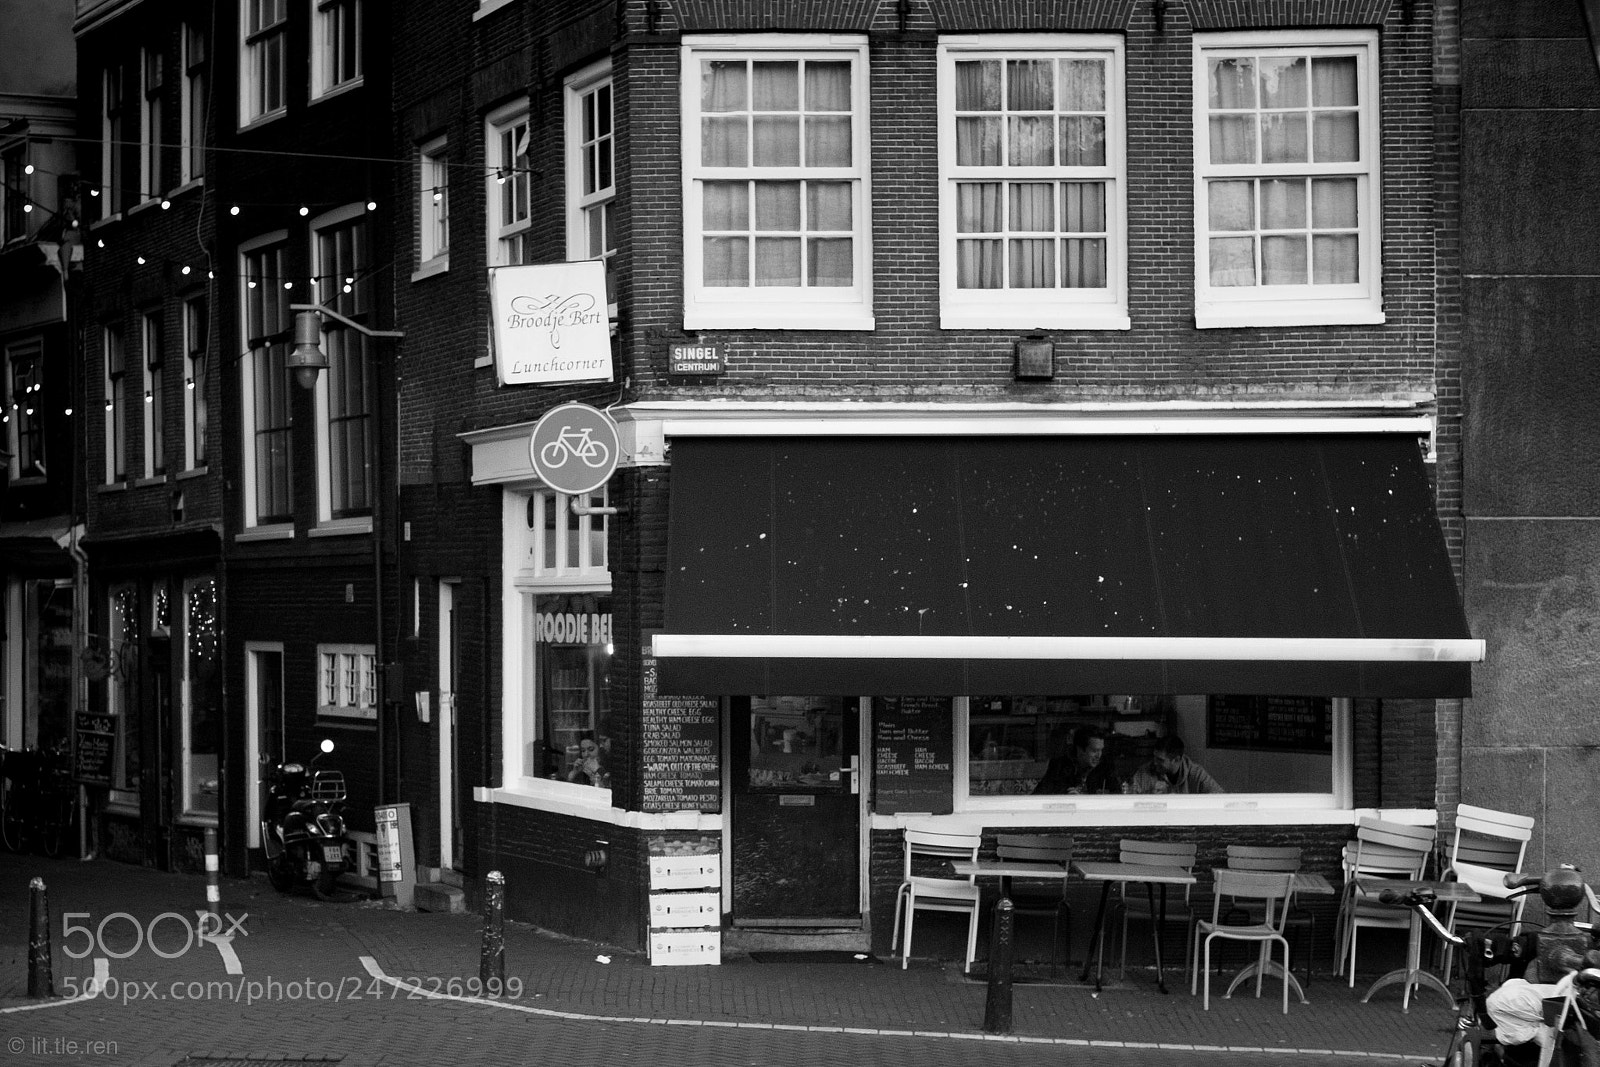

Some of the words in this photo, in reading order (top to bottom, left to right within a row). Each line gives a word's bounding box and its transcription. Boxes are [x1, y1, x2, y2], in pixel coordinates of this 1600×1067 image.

[507, 309, 565, 330] Broodje
[569, 309, 602, 327] Bert
[674, 346, 719, 361] SINGEL
[511, 356, 605, 375] Lunchcorner
[674, 362, 720, 372] (CENTRUM)
[536, 612, 588, 644] ROODJE
[643, 708, 666, 716] HEALTHY
[667, 708, 686, 716] CHEESE
[688, 708, 702, 716] EGG
[643, 724, 660, 732] TUNA
[661, 724, 681, 732] SALAD
[670, 763, 683, 771] OUT
[677, 794, 698, 802] TOMATO
